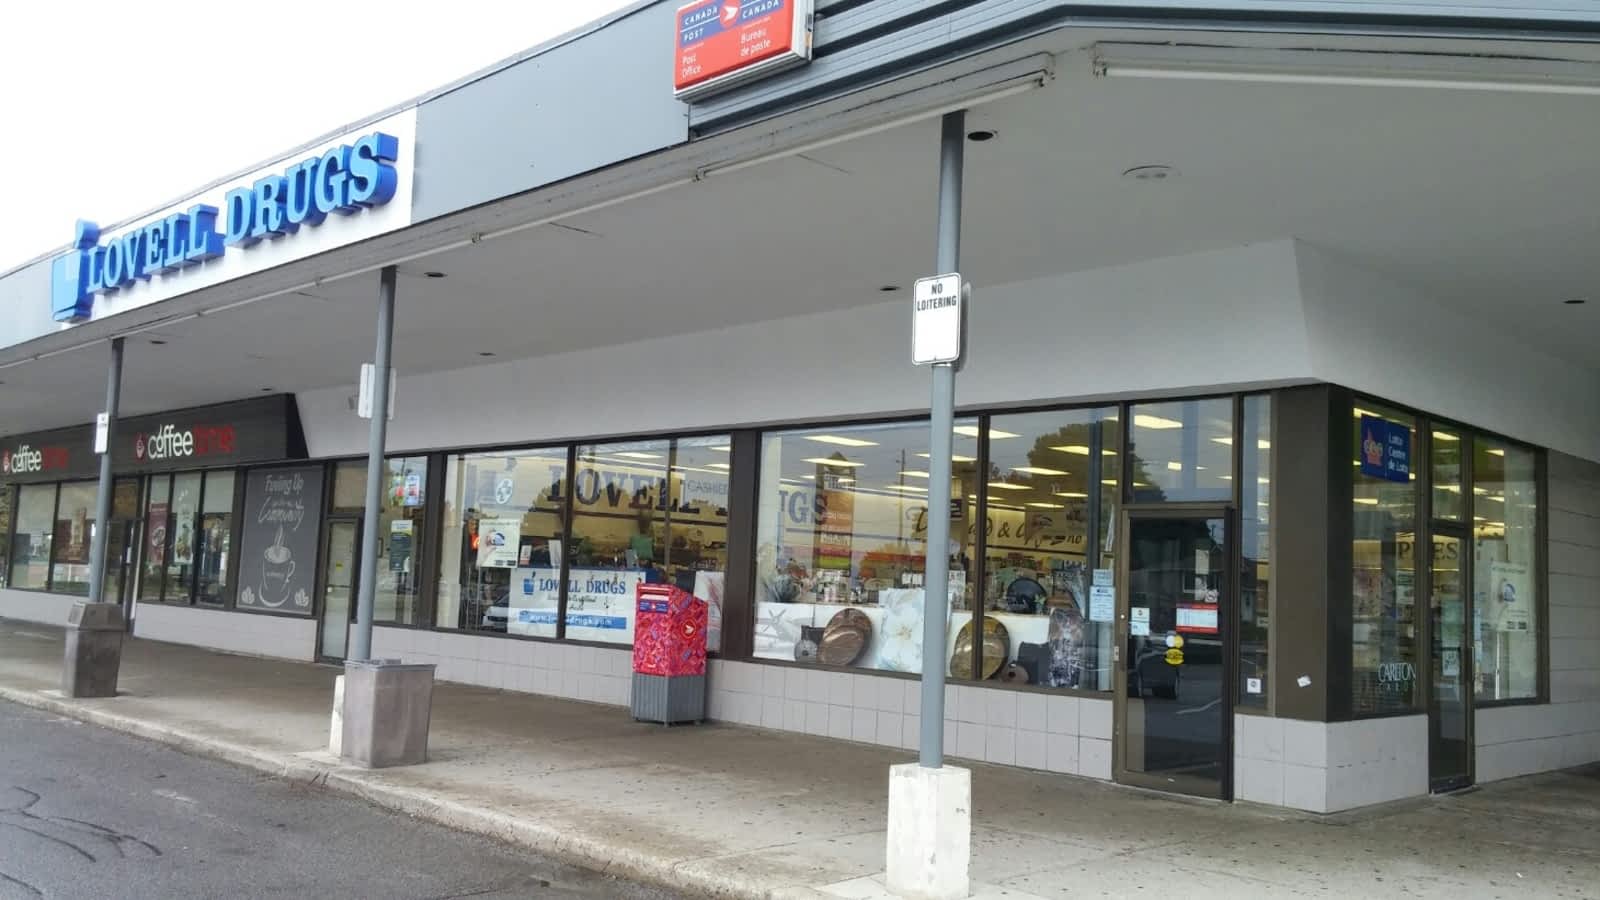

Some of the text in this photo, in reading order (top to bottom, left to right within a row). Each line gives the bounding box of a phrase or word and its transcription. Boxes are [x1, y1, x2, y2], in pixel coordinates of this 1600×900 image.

[684, 6, 718, 25] CANADA
[742, 0, 780, 19] CANADA
[684, 28, 704, 42] POST
[741, 27, 767, 44] Bureau
[740, 39, 771, 57] de poste
[682, 53, 696, 65] Post
[86, 132, 399, 295] LOVELL DRUGS
[931, 283, 943, 295] NO
[917, 295, 957, 311] LOITERING
[149, 424, 194, 459] coffee
[11, 444, 42, 474] coffee
[540, 578, 627, 595] LOVLL DRUGS
